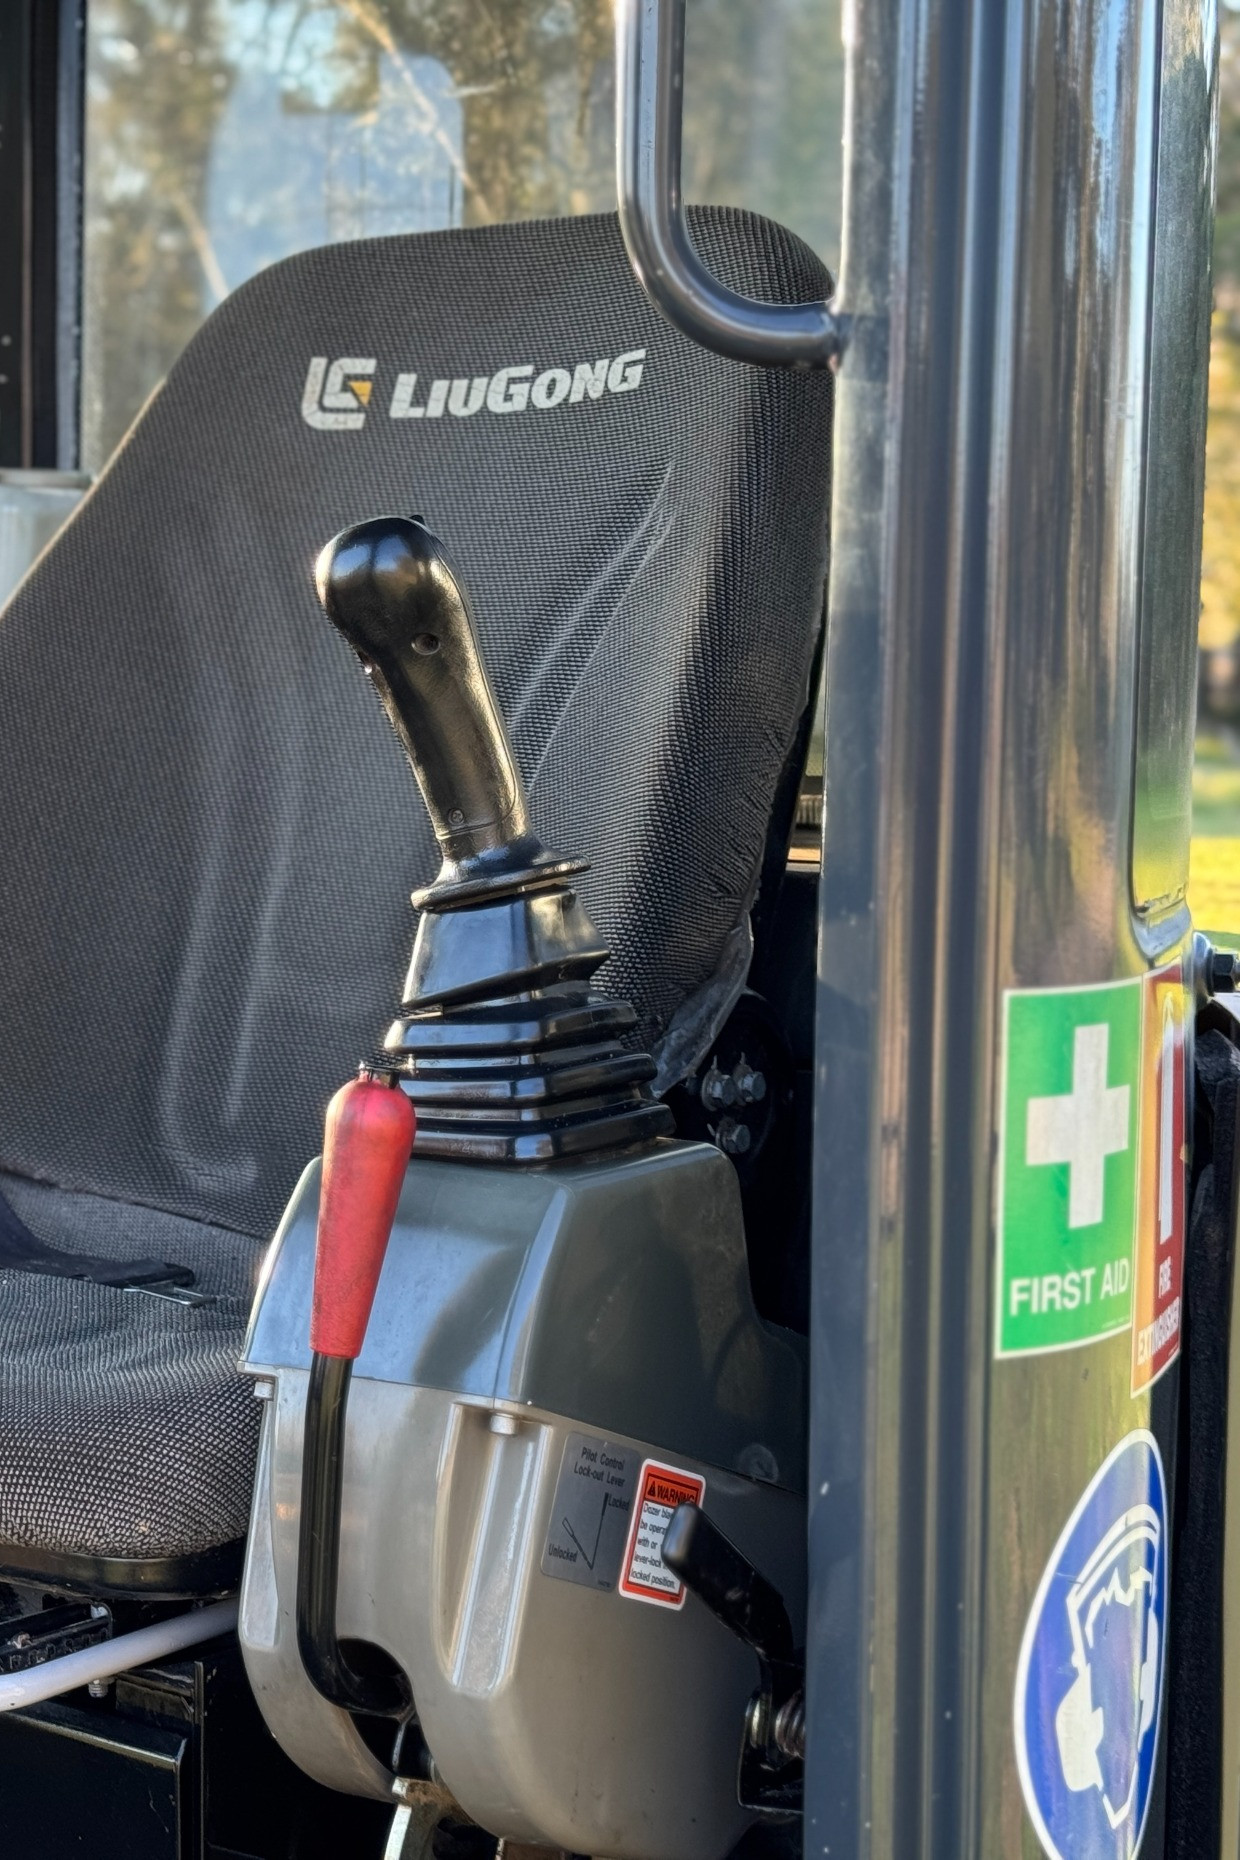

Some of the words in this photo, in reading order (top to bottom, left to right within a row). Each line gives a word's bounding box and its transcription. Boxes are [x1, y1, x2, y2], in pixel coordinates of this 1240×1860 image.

[1010, 1267, 1096, 1316] FIRST
[1100, 1258, 1129, 1300] AID
[581, 1447, 598, 1462] Pilot
[600, 1453, 626, 1471] Control
[574, 1461, 604, 1482] Lock-out
[606, 1474, 626, 1487] Lever
[608, 1494, 631, 1511] Locked
[657, 1485, 695, 1503] WARNING
[548, 1543, 578, 1563] Unlocked
